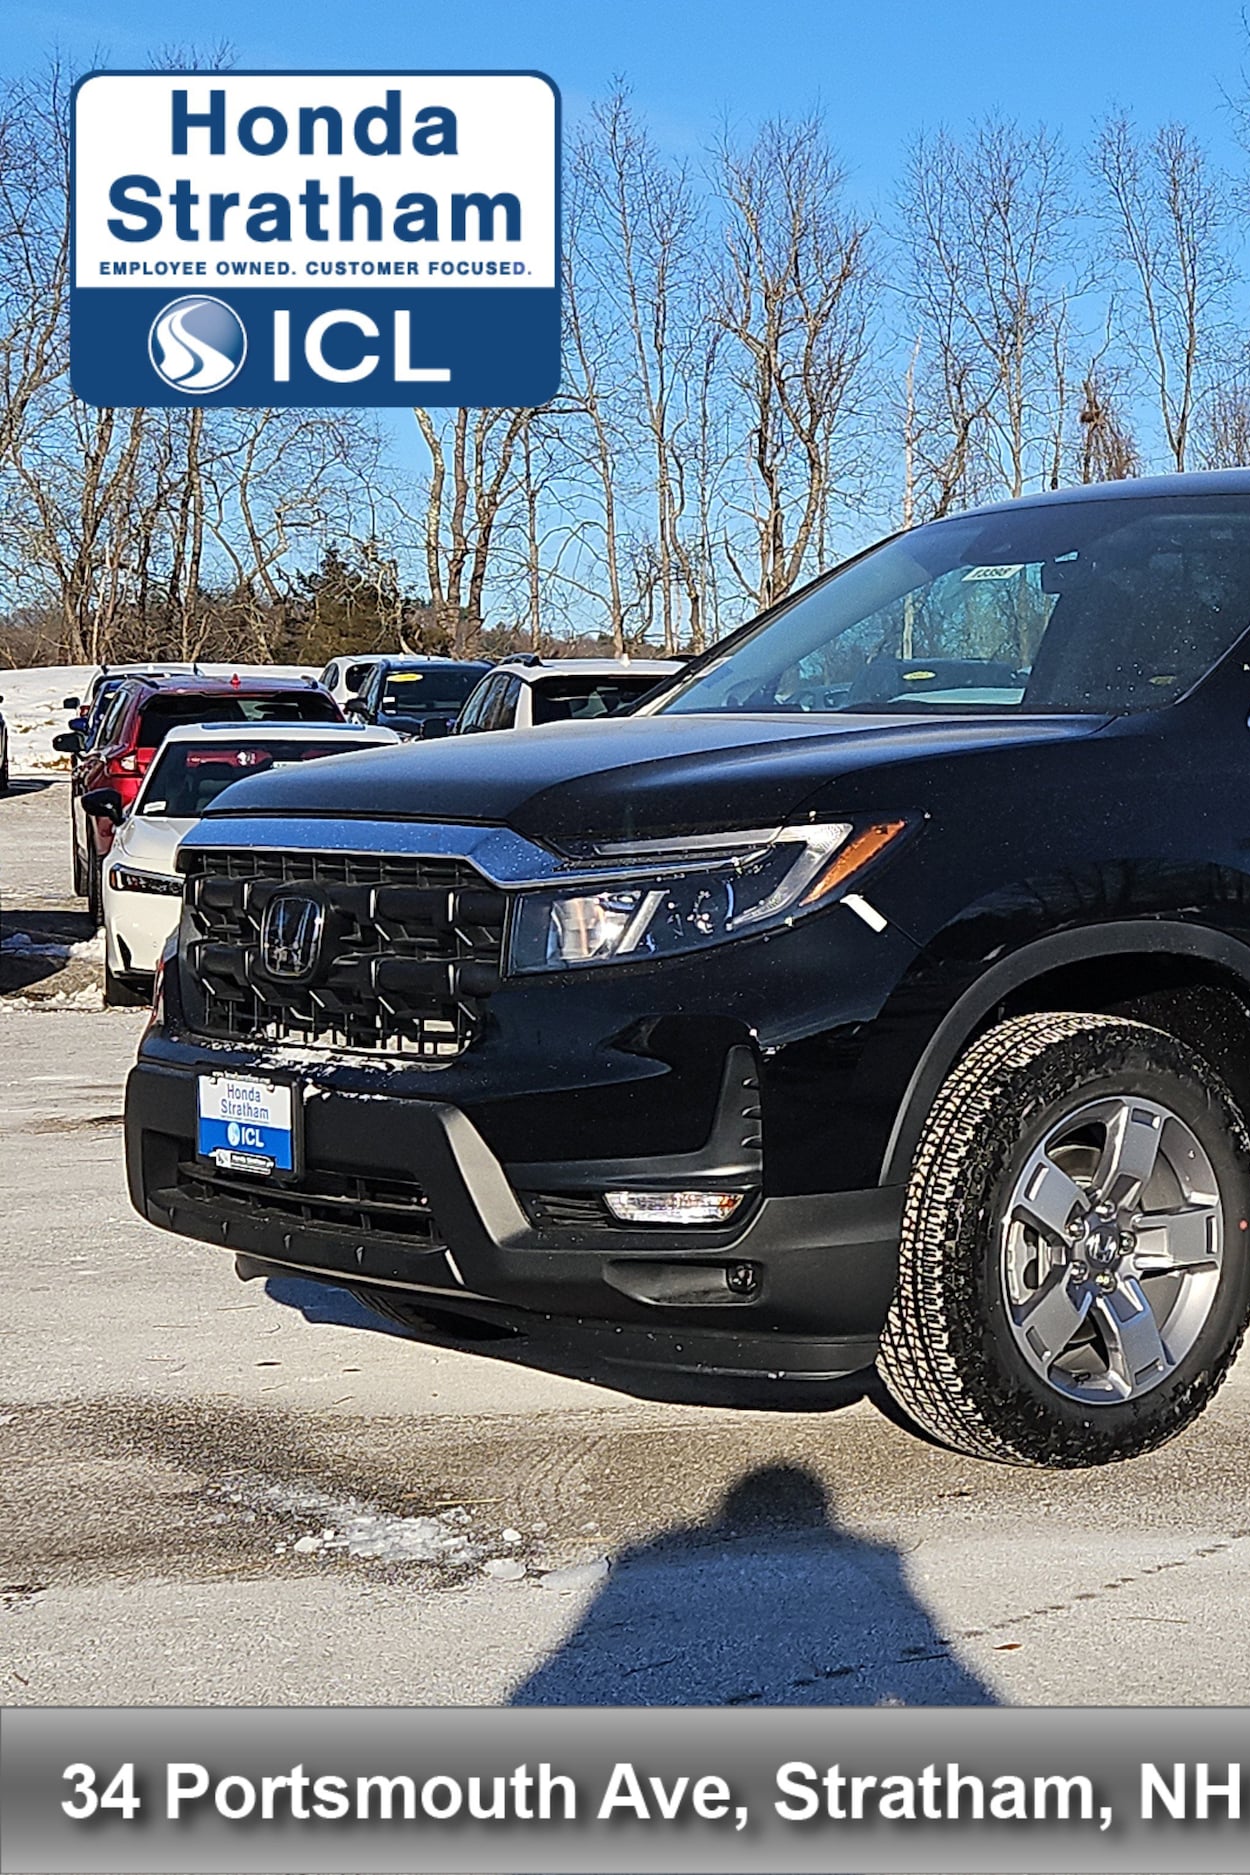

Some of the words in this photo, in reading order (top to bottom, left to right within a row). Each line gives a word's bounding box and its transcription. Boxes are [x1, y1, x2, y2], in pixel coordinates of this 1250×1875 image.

[227, 1083, 261, 1102] Honda
[221, 1098, 269, 1120] Stratham
[241, 1126, 265, 1148] ICL
